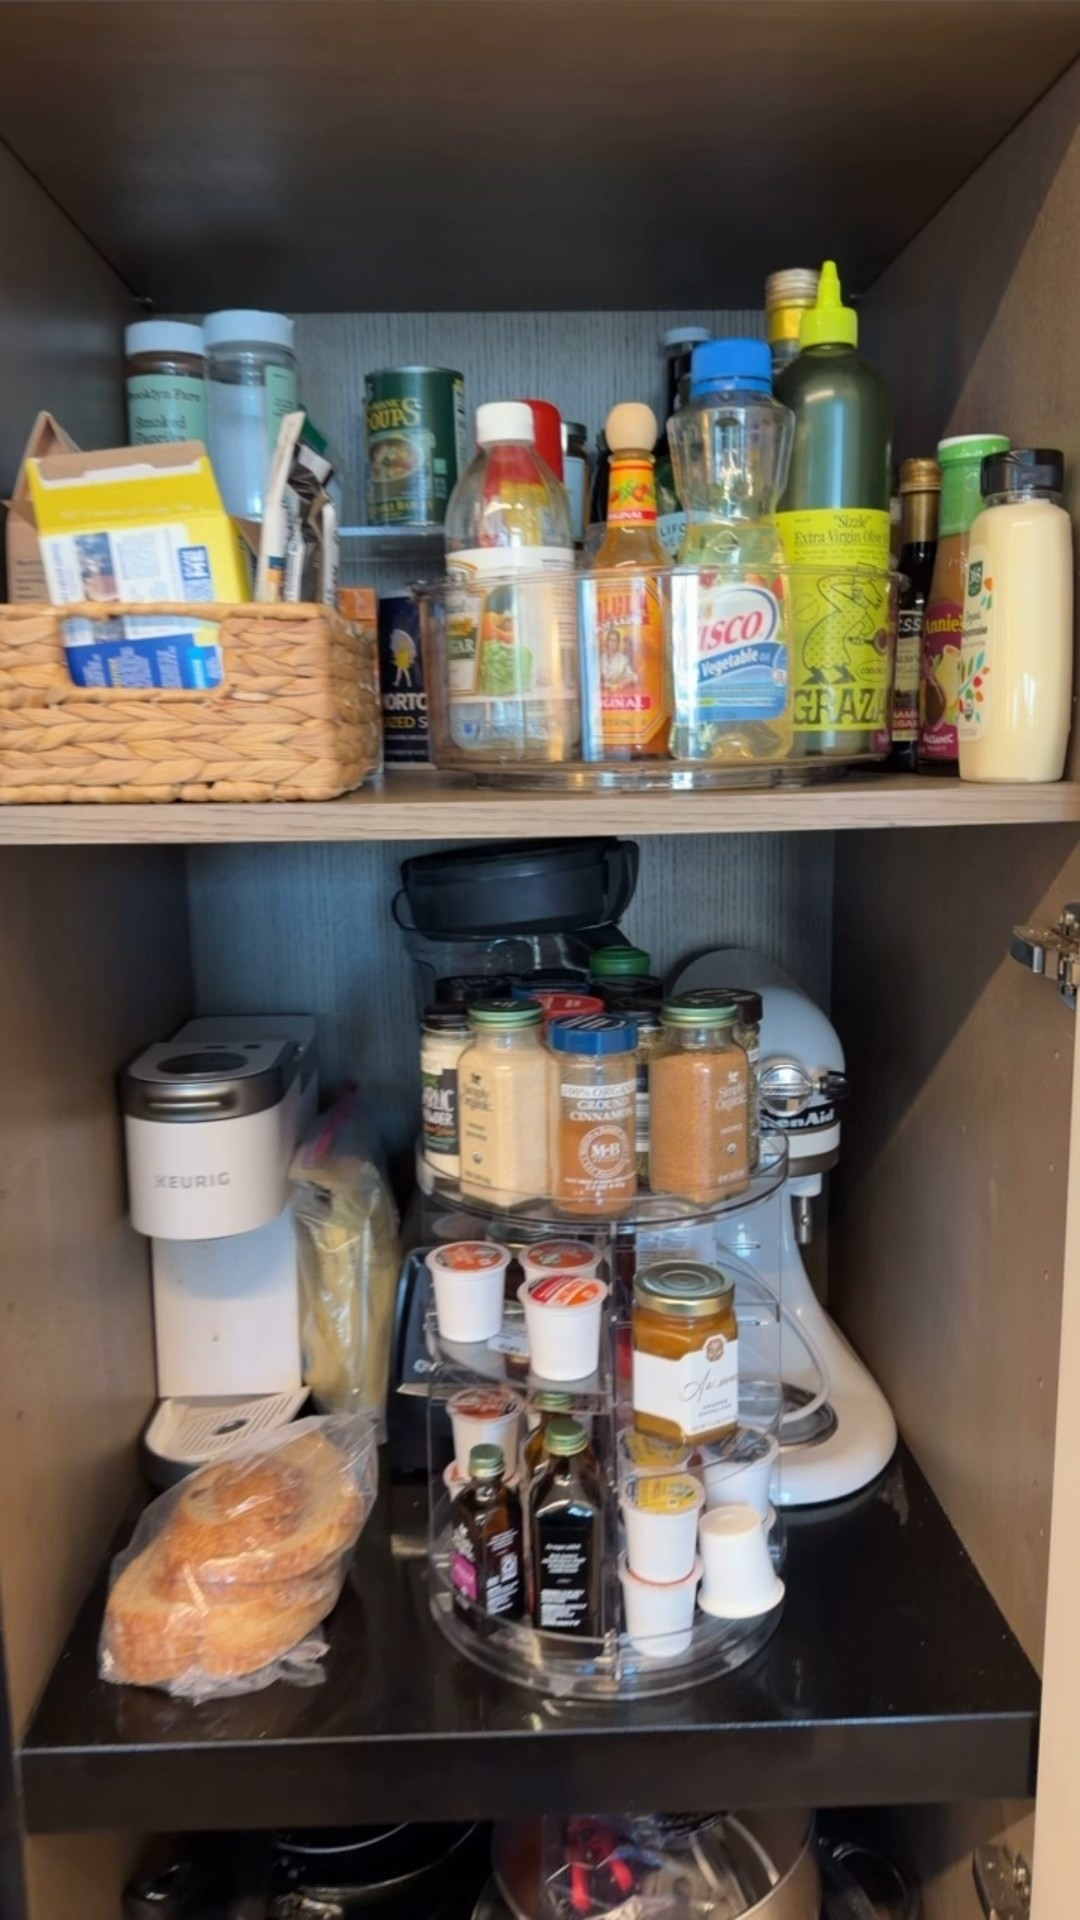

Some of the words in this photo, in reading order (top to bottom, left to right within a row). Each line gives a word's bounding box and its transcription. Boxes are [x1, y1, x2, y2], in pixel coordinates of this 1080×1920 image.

[369, 397, 423, 431] OUPS
[794, 532, 825, 545] Extra
[828, 529, 861, 546] Virgin
[699, 610, 764, 652] ISCO
[701, 647, 759, 677] Vegetable
[576, 1096, 630, 1111] GROUND
[154, 1171, 231, 1189] KEURIG
